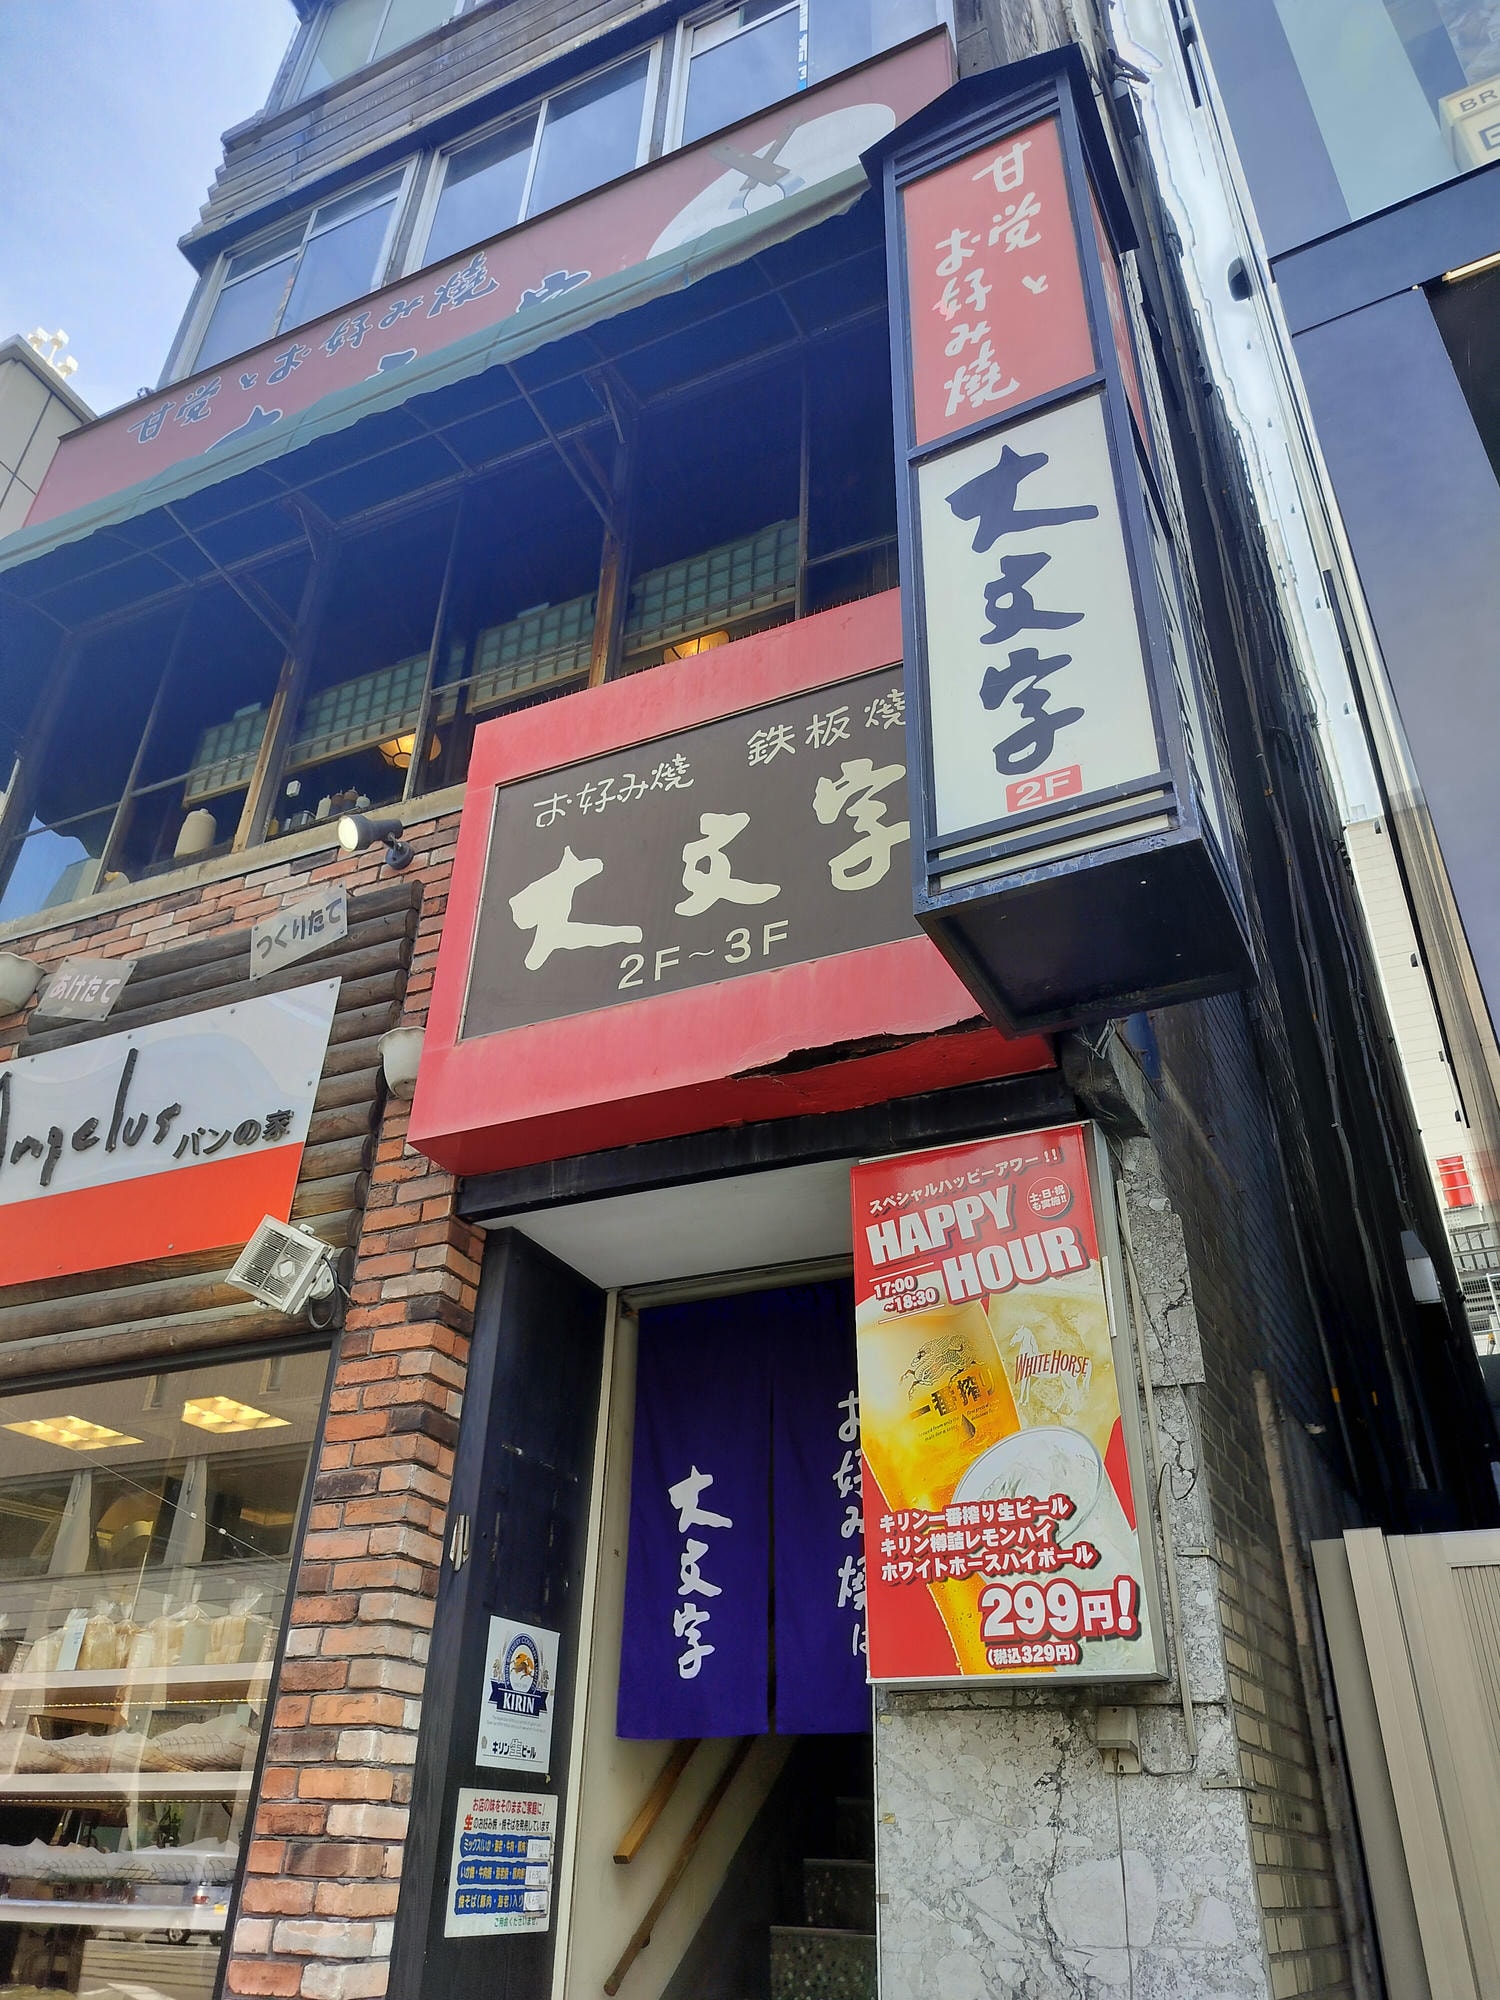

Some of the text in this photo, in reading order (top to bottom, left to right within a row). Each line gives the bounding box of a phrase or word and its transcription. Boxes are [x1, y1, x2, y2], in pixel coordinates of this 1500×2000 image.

[945, 444, 1099, 776] 大文字
[1016, 770, 1071, 807] 2F
[508, 758, 911, 971] 大文字
[256, 898, 344, 959] つくりたて
[49, 972, 122, 1004] あげたて
[865, 1185, 1011, 1266] HAPPY
[942, 1226, 1083, 1300] HOUR
[873, 1275, 916, 1298] 17:00
[1013, 1350, 1090, 1385] WHITE HORSE
[880, 1497, 1069, 1534] キリン一番搾り生ビール
[881, 1523, 1051, 1558] キリン樽詰レモンハイ
[668, 1465, 734, 1679] 大文字
[881, 1544, 1094, 1582] ホワイトホースハイボール
[981, 1579, 1132, 1638] 299円!
[987, 1643, 1077, 1665] (税込329円)
[502, 1692, 535, 1714] KIRIN
[491, 1738, 537, 1759] キリン生ビール
